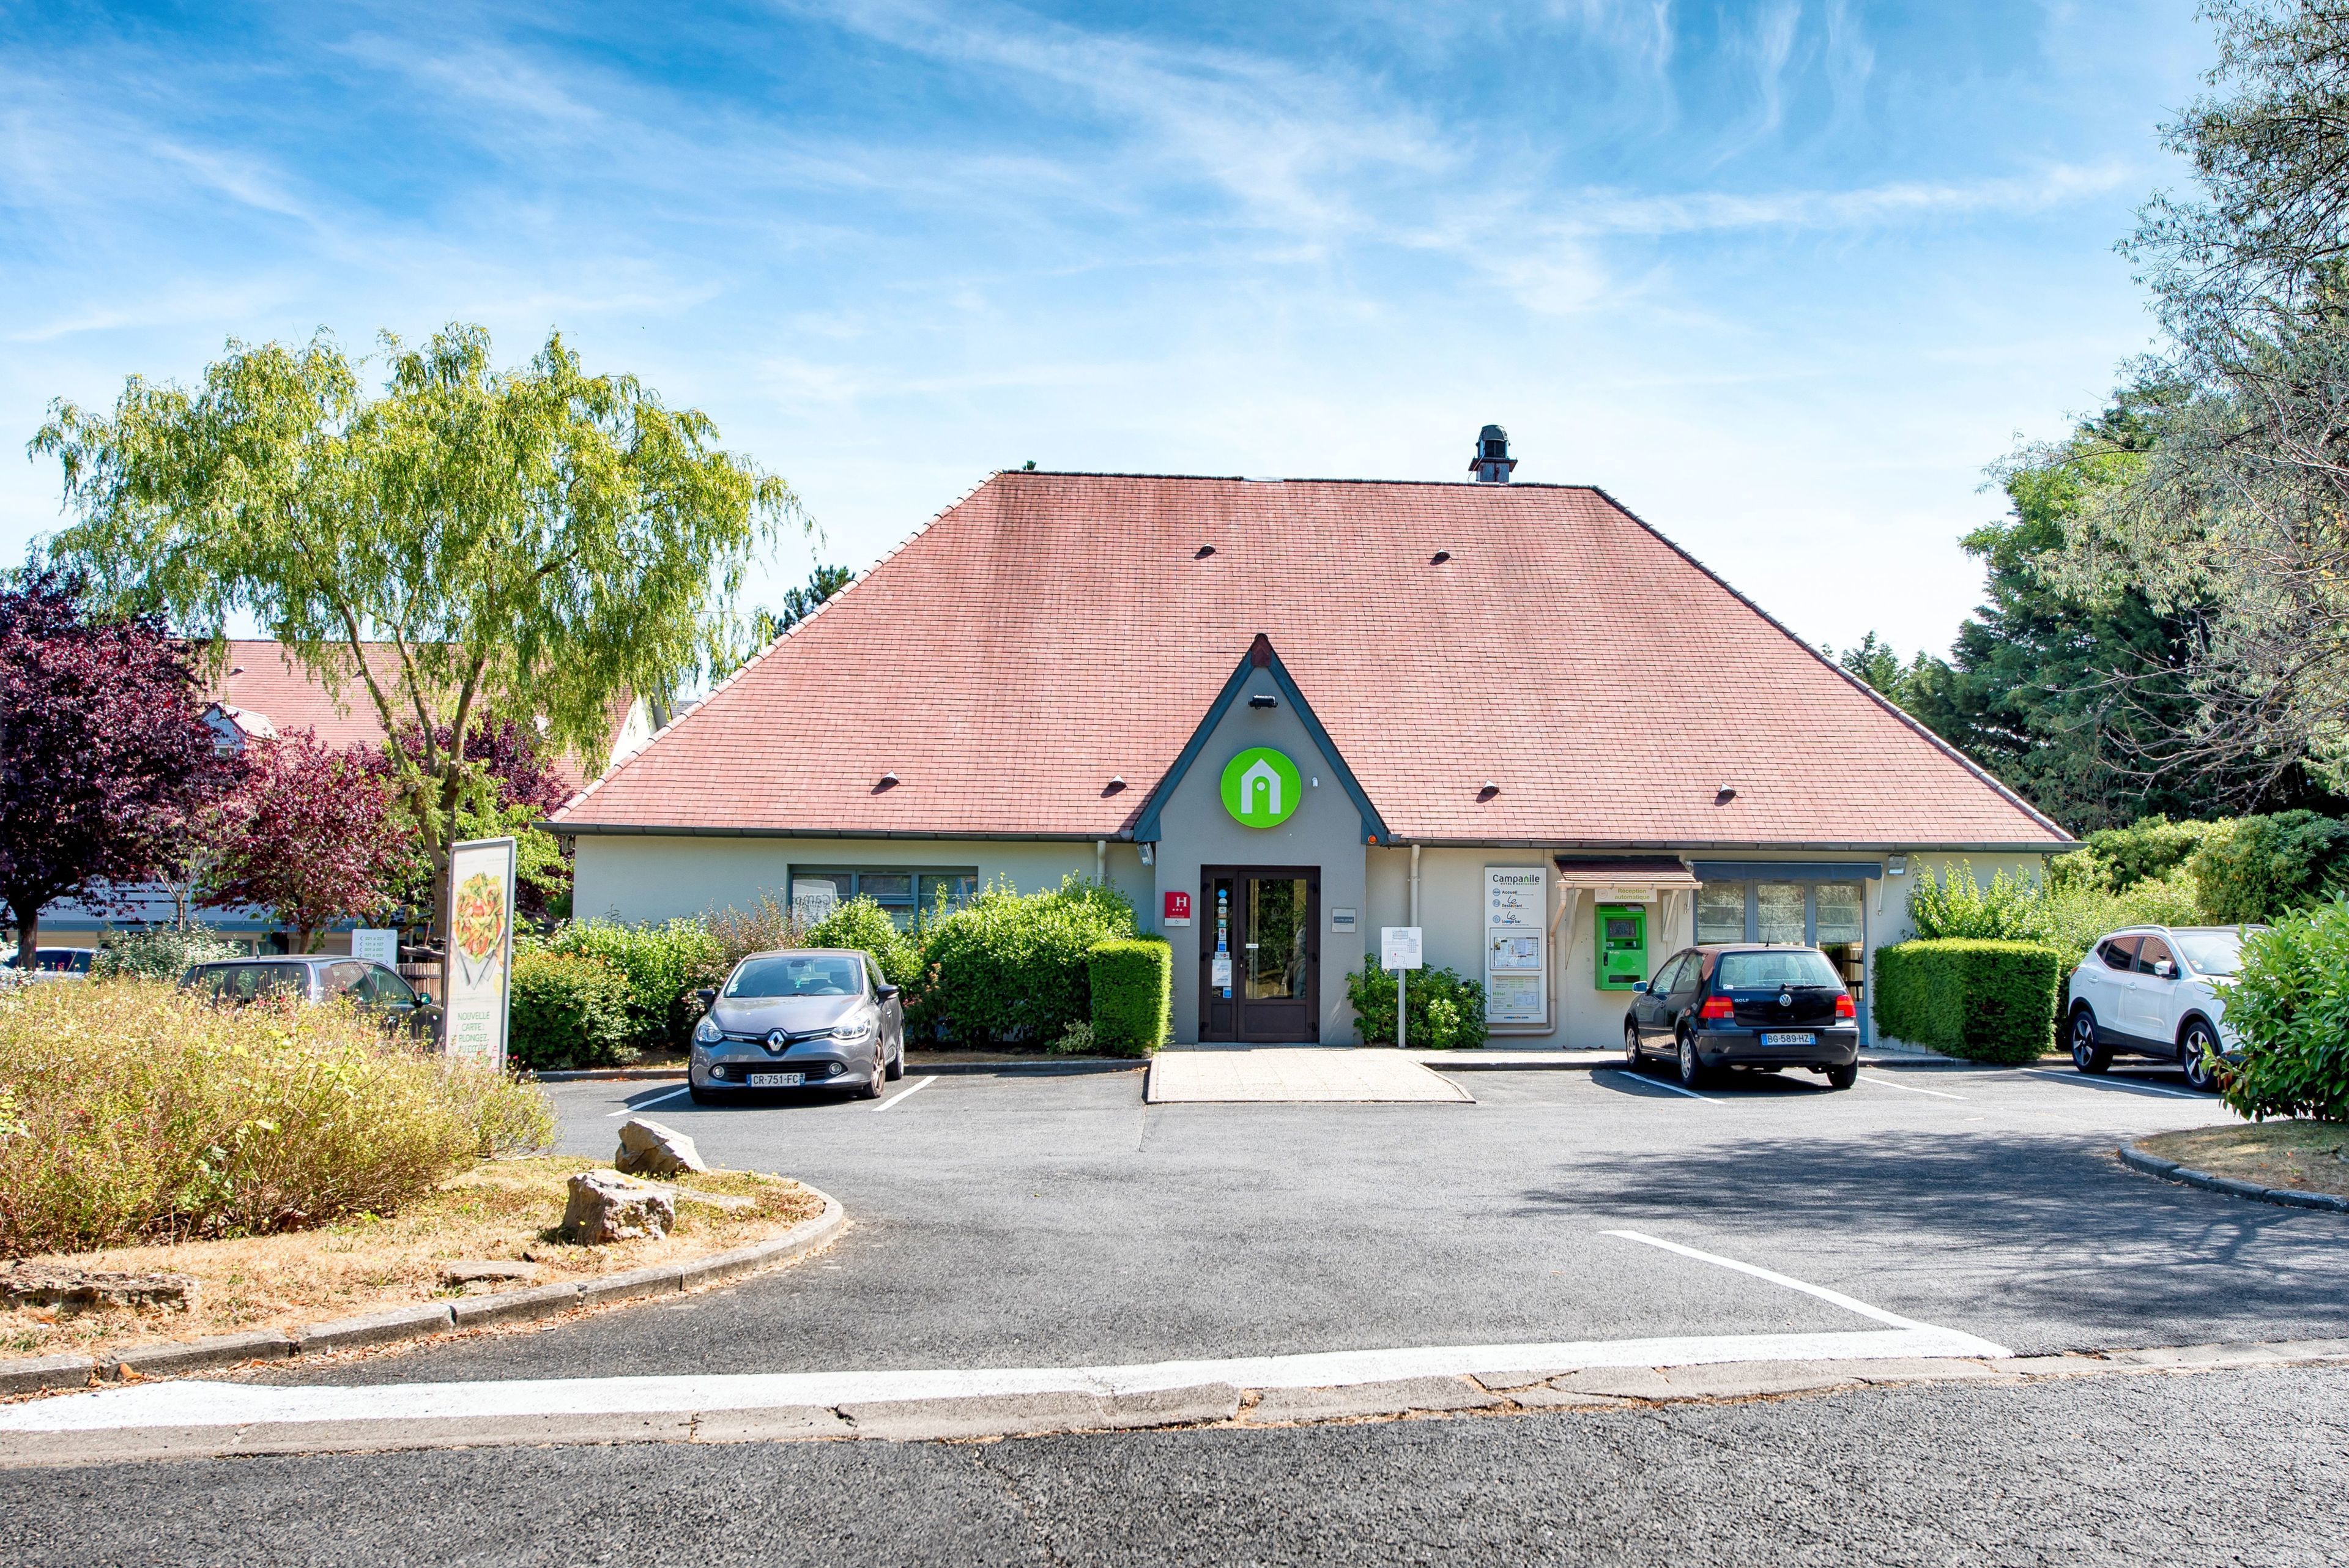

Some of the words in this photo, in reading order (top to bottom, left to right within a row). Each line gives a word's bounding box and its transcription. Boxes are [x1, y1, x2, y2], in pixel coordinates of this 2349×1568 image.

[1493, 874, 1540, 885] Campanile
[1176, 896, 1187, 907] H
[458, 1011, 490, 1020] NOUVELLE
[458, 1033, 488, 1042] PLONGEZ
[1767, 1034, 1809, 1043] BG-589-HZ
[753, 1074, 798, 1085] CR-751-FC
